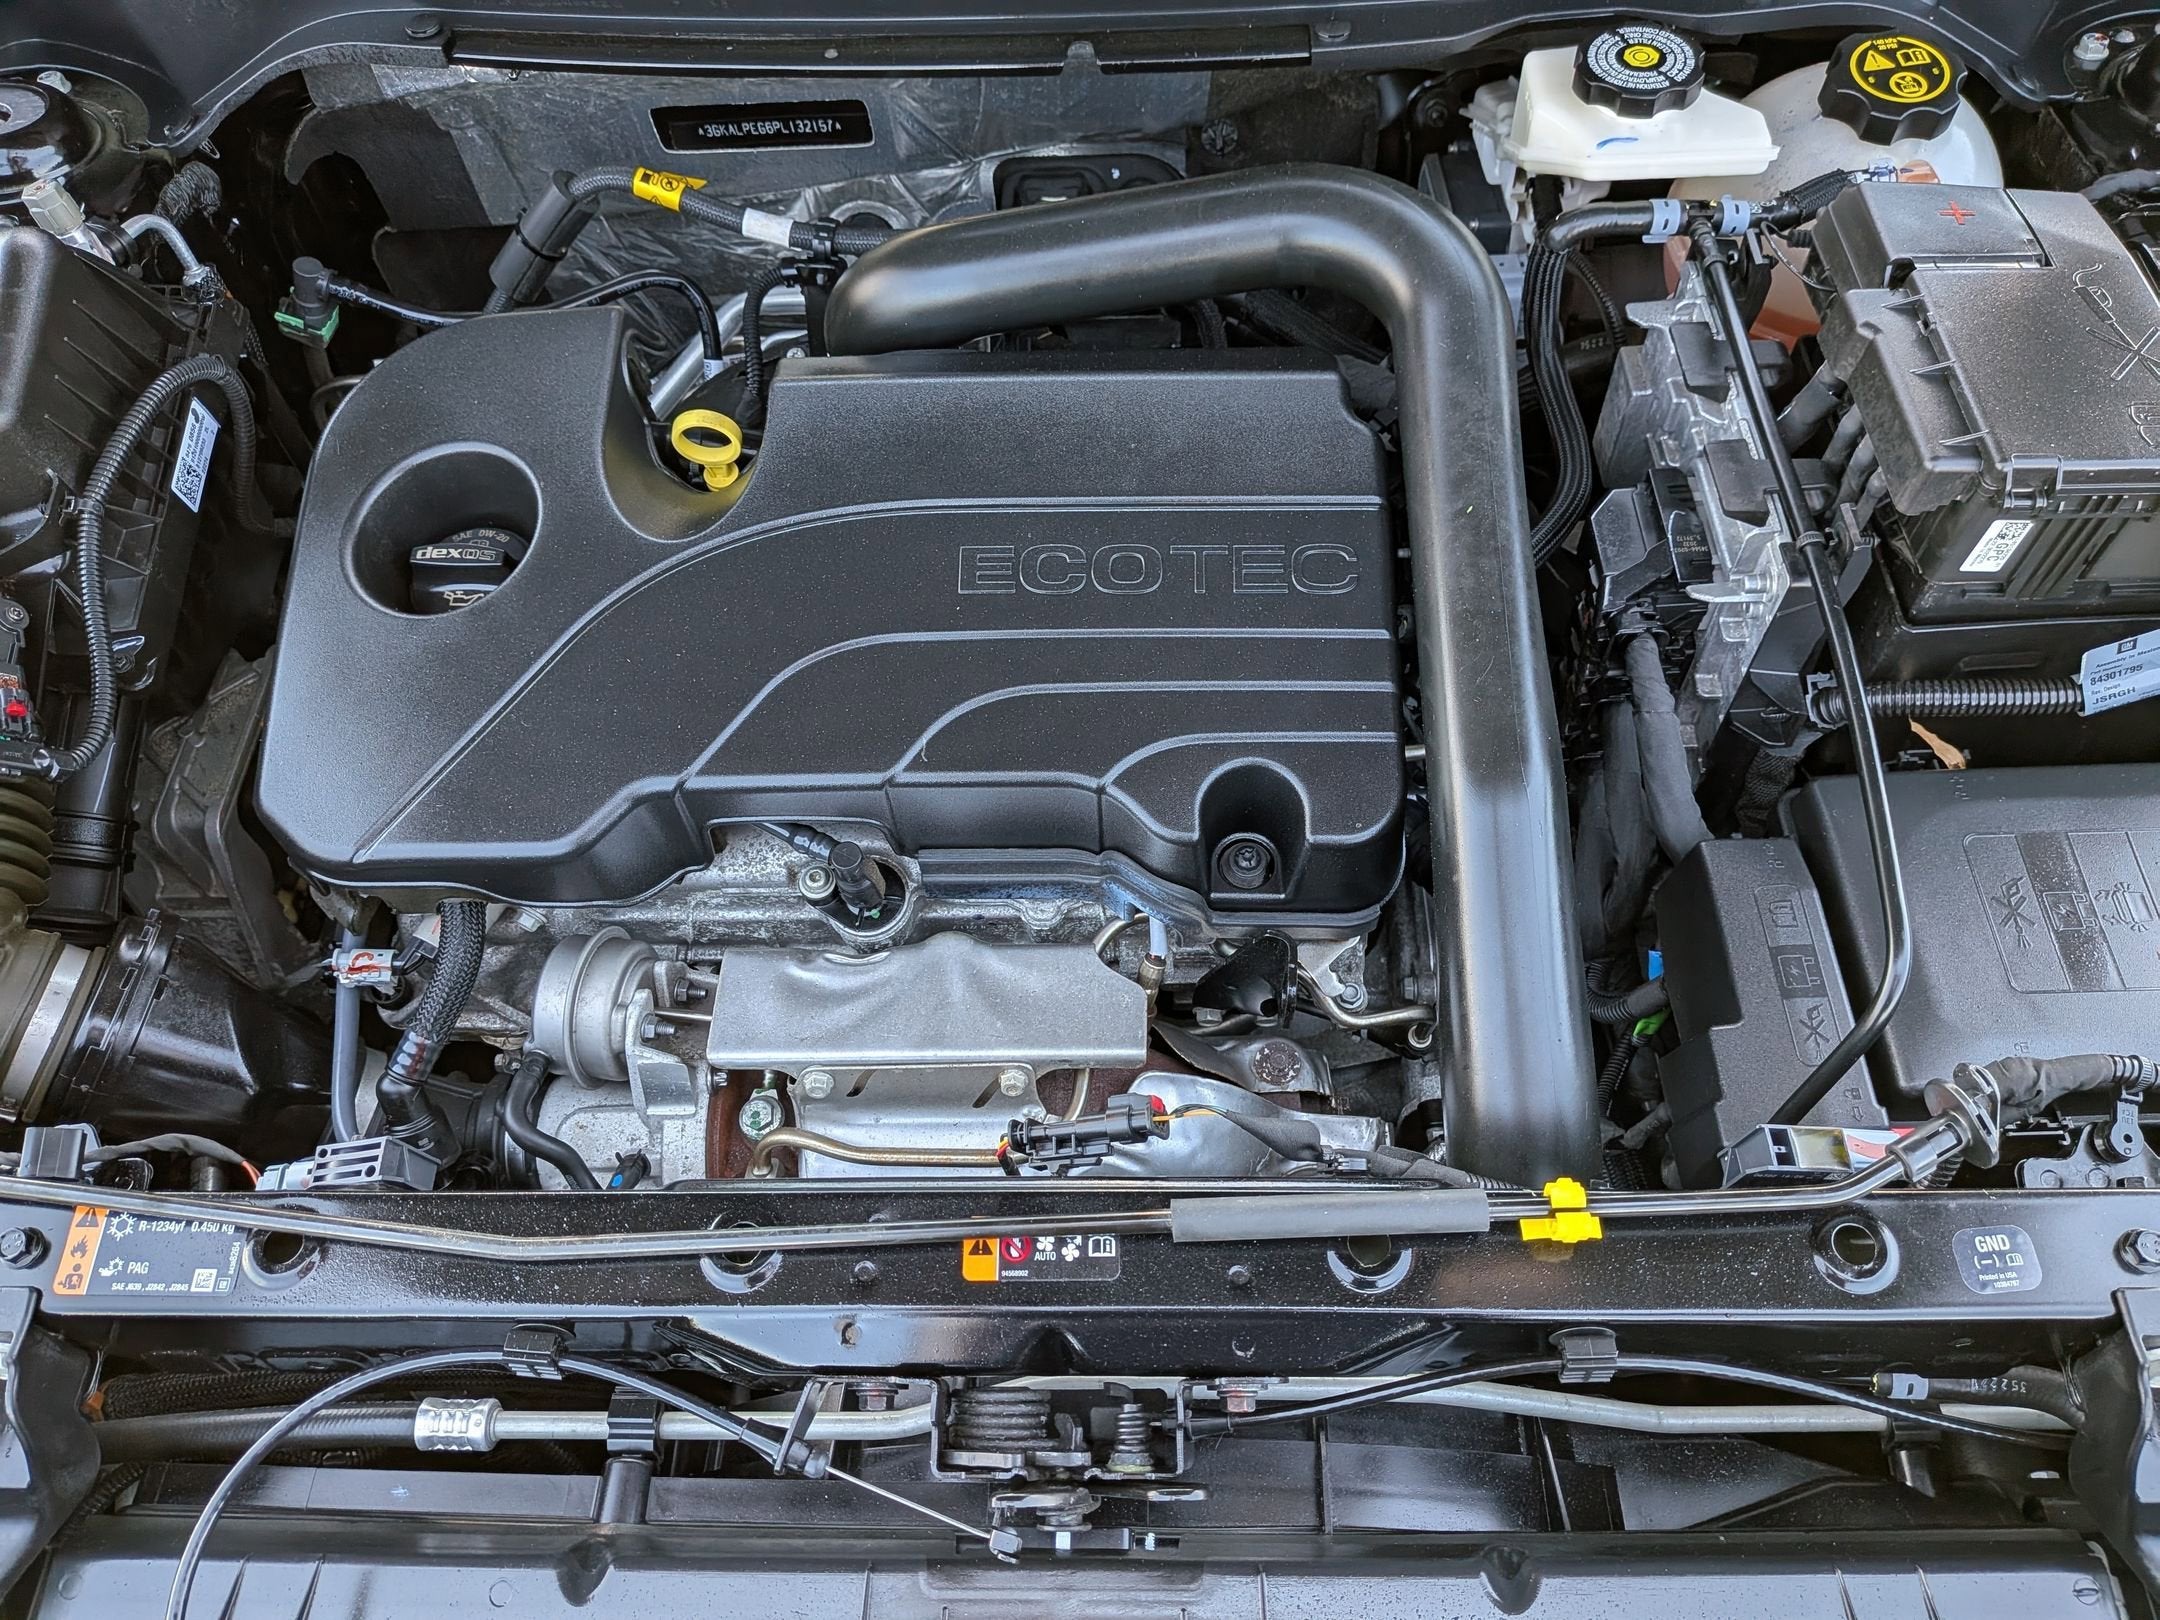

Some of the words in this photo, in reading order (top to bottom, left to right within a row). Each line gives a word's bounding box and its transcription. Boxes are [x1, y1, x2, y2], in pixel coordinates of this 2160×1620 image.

[416, 546, 496, 560] dexos
[1986, 542, 2009, 562] GPC
[958, 544, 1358, 595] ECOTEC
[2090, 663, 2144, 686] 84301795
[2092, 686, 2136, 705] JSRGH
[138, 1221, 185, 1234] R-1234yf
[1974, 1234, 2010, 1253] GND
[1034, 1251, 1056, 1261] AUTO
[127, 1261, 149, 1275] PAG
[112, 1282, 126, 1291] SAE
